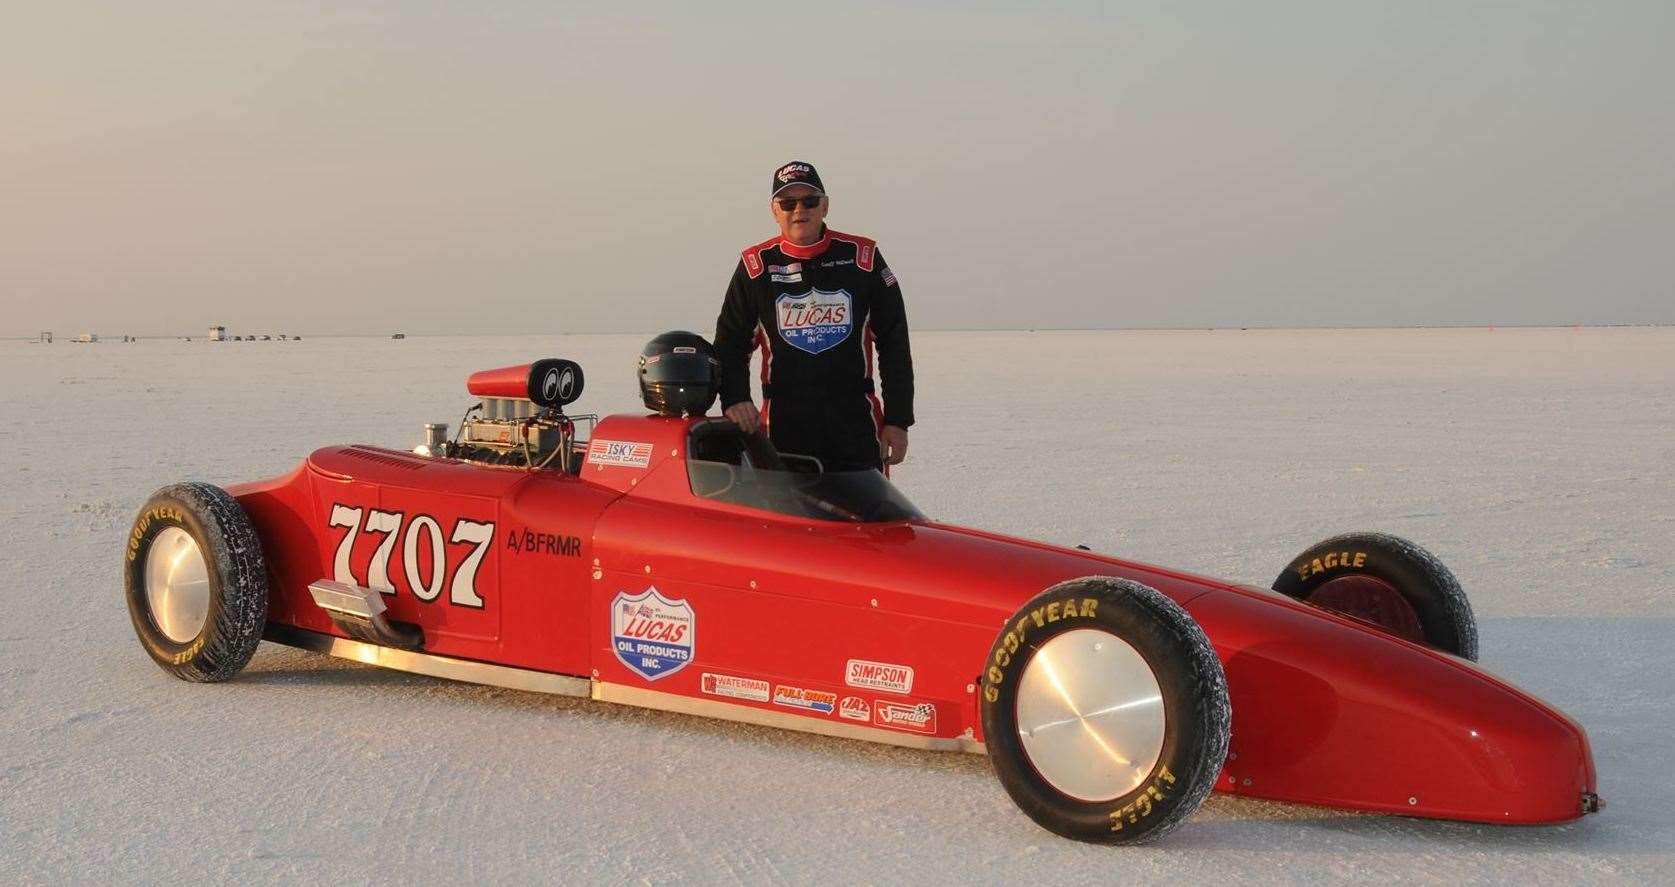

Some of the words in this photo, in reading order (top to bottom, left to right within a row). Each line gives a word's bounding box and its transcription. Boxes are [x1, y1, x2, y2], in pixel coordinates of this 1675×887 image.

[778, 164, 810, 178] LUCAS
[784, 306, 846, 327] LUCAS
[802, 326, 847, 336] PRODUCTS
[591, 453, 620, 462] RACING
[607, 443, 636, 456] ISKY
[506, 527, 582, 558] A/BFRMR
[328, 502, 496, 610] 7707
[1296, 551, 1368, 582] EAGLE
[623, 618, 688, 643] LUCAS
[618, 641, 635, 652] OIL
[637, 643, 688, 661] PRODUCTS
[984, 598, 1099, 703] GOODYEAR
[641, 657, 662, 669] INC.
[850, 663, 908, 684] SIMPSON
[717, 676, 768, 692] WATERMAN
[870, 680, 906, 690] RESTRAINTS
